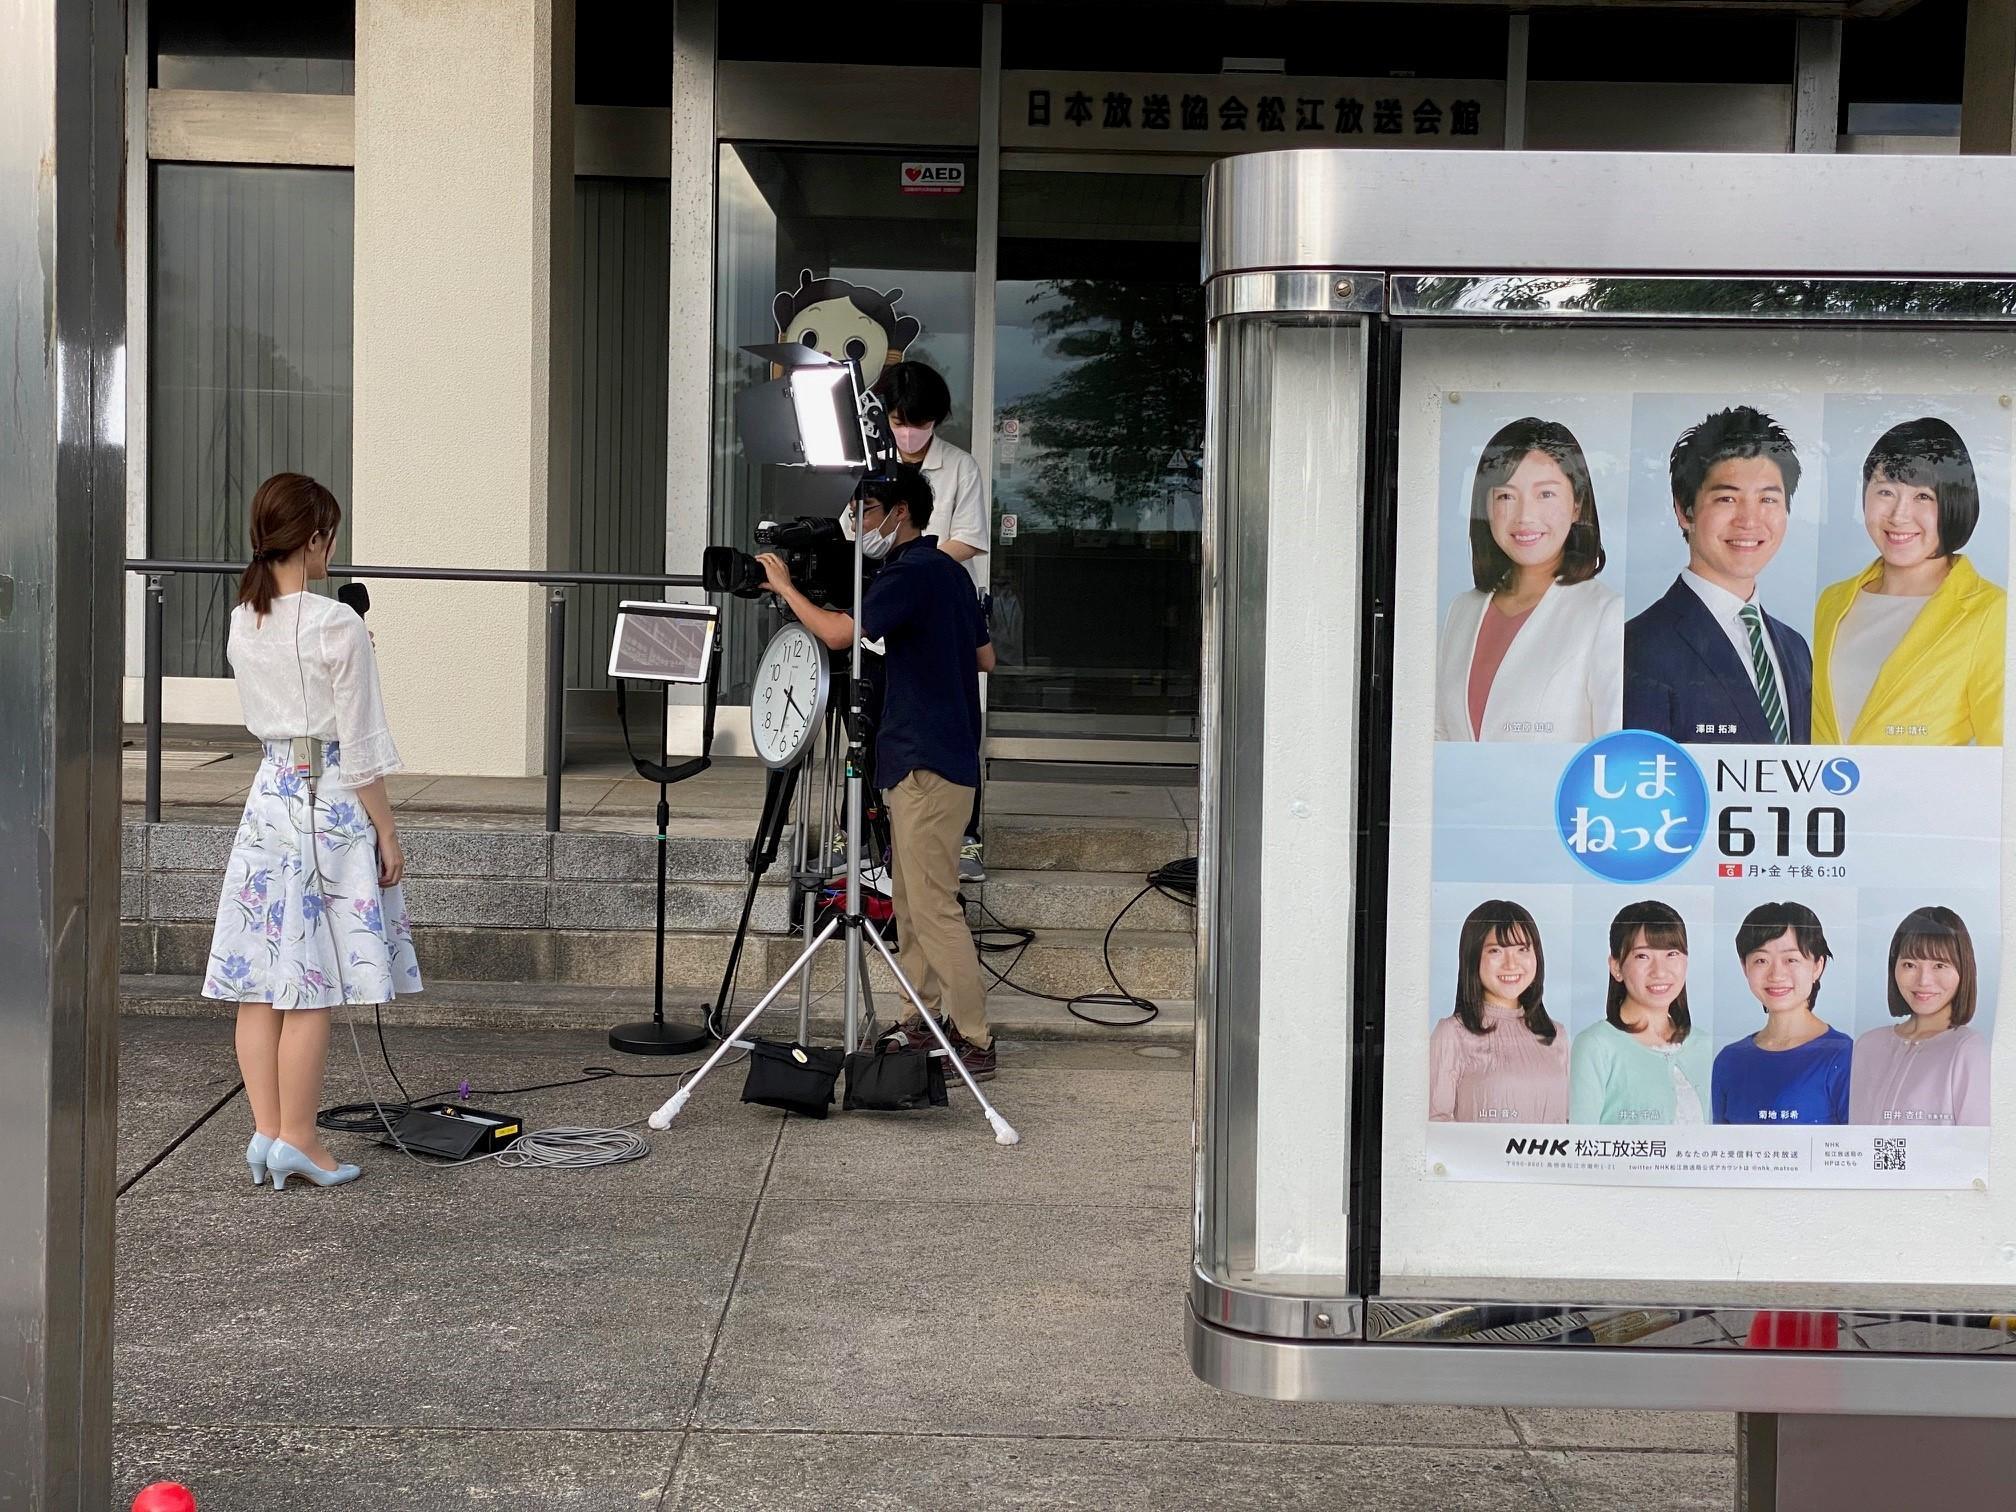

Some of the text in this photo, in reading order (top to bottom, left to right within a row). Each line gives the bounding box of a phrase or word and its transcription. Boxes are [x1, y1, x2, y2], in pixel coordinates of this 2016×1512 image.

[1028, 89, 1480, 135] 日本放送協会松江放送会館
[920, 167, 962, 180] AED
[783, 645, 791, 663] 11
[793, 640, 803, 658] 12
[771, 664, 781, 681] 10
[809, 662, 817, 680] 2
[765, 686, 773, 704] 9
[809, 687, 816, 706] 3
[764, 711, 772, 729] 8
[771, 729, 779, 746] 7
[779, 735, 786, 753] 6
[791, 730, 799, 748] 5
[1593, 754, 1678, 800] しま
[1716, 758, 1852, 794] NEWS
[1567, 807, 1693, 854] ねっと
[1718, 806, 1846, 857] 610
[1787, 864, 1814, 878] 午後
[1817, 866, 1846, 878] 6:10
[1479, 1108, 1497, 1118] 山口
[1883, 1110, 1902, 1120] 田井
[1505, 1138, 1667, 1158] NHK 松江放送局
[1676, 1150, 1799, 1159] あなたの声と受信料で公共放送
